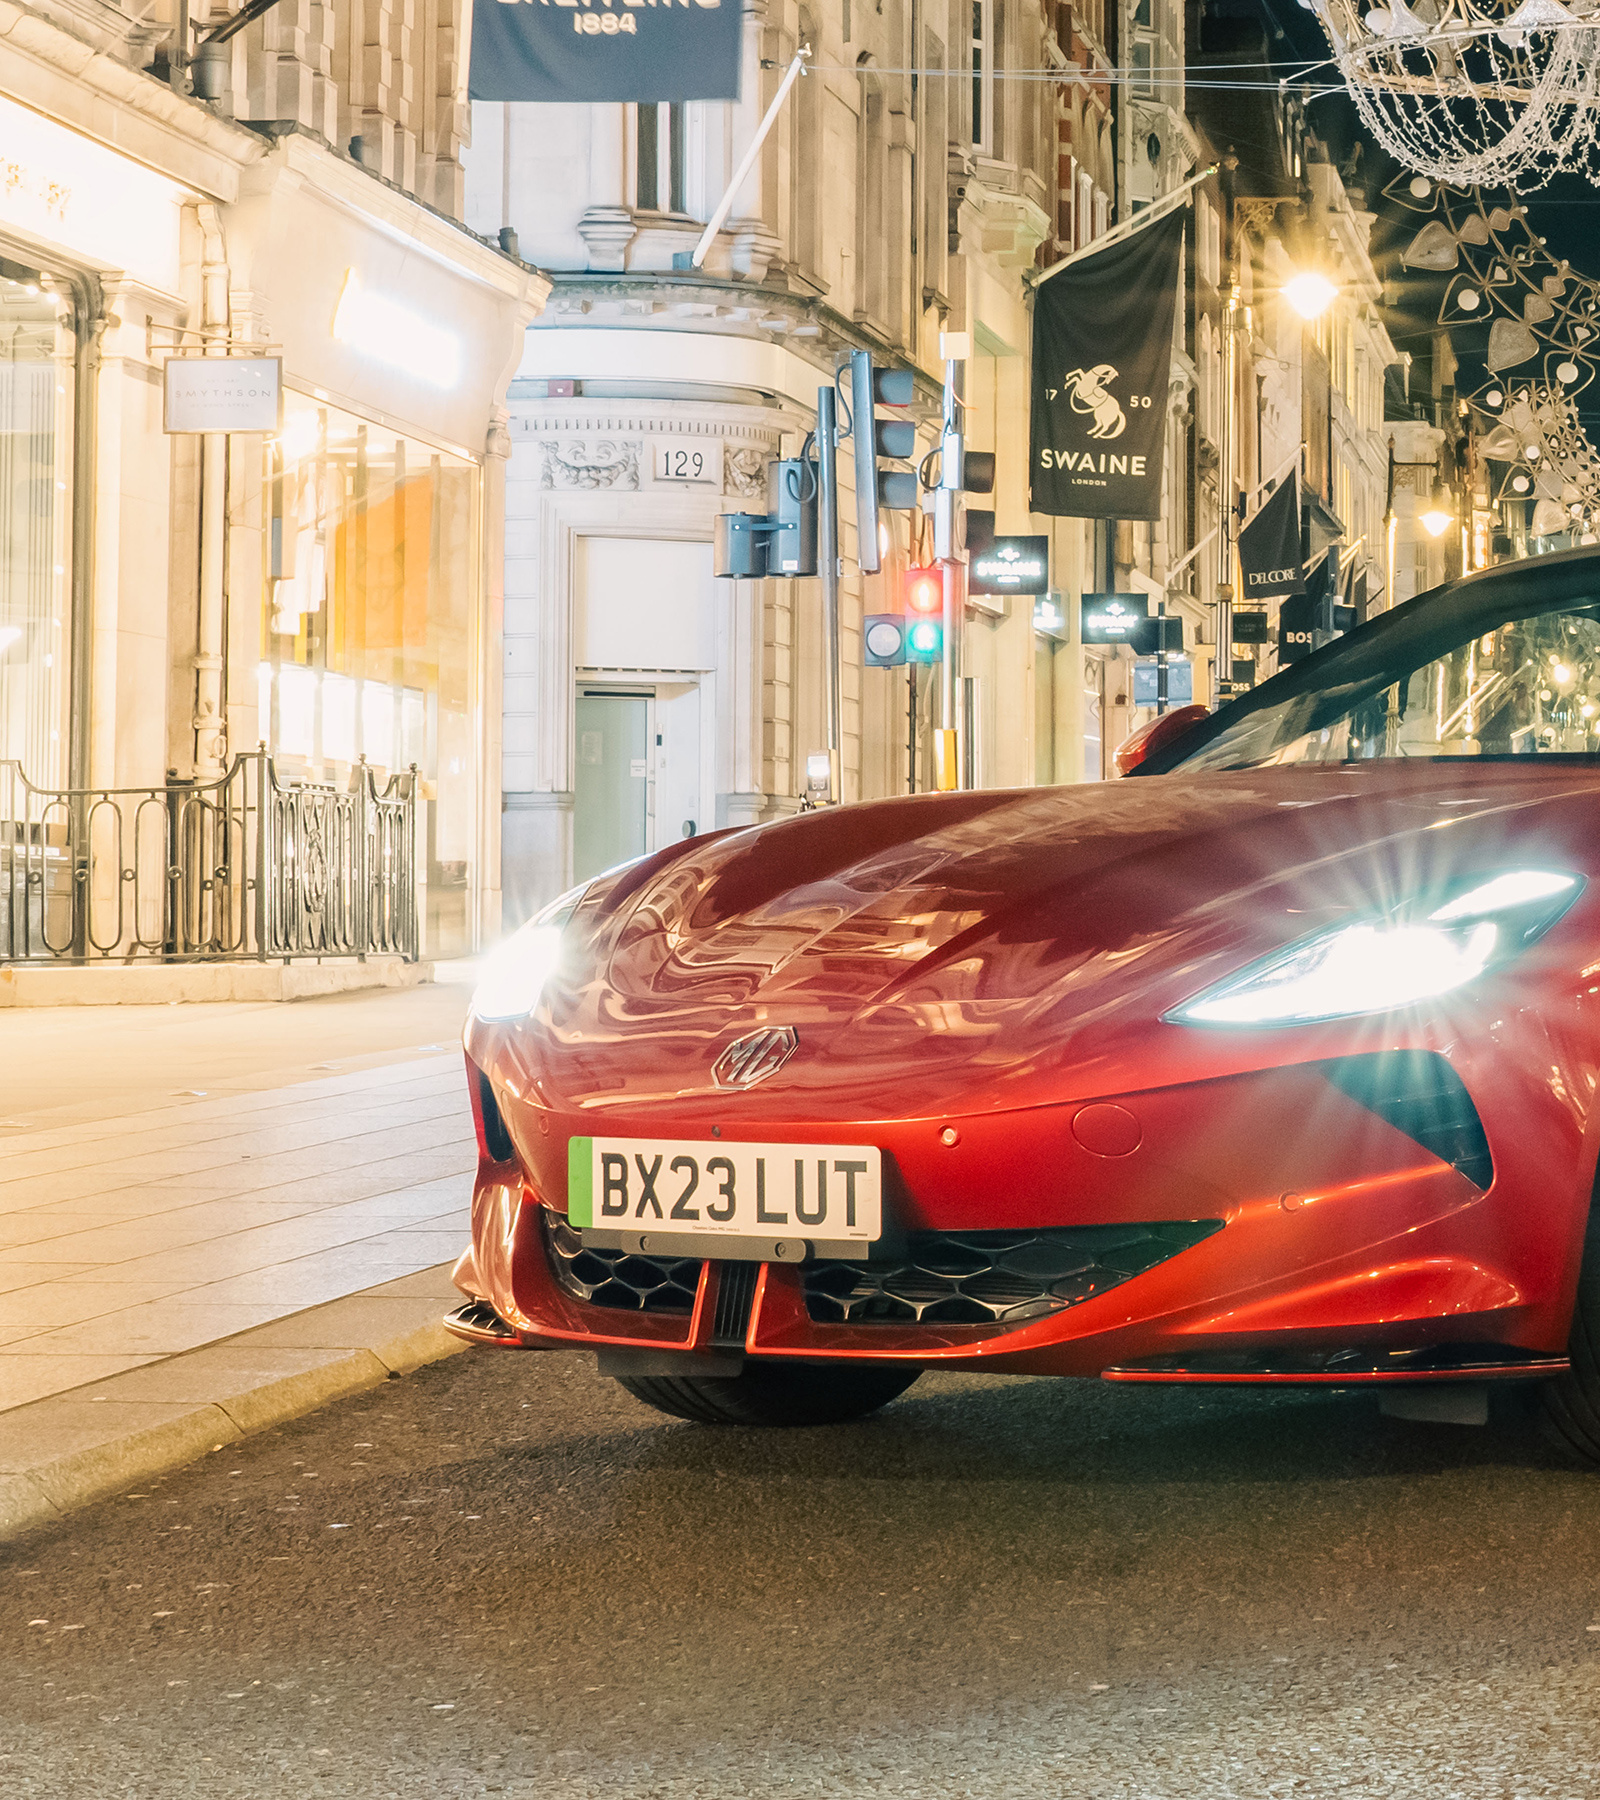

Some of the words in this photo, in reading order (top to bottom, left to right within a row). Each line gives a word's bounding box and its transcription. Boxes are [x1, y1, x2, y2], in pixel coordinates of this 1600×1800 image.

[573, 12, 637, 35] 1884
[175, 389, 271, 399] SMYTHSON
[1045, 388, 1058, 401] 17
[1129, 395, 1152, 408] 50
[664, 450, 704, 478] 129
[1040, 448, 1147, 476] SWAINE
[1071, 478, 1107, 487] LONDON
[1248, 567, 1298, 586] DELCORE
[1286, 631, 1313, 644] BOS
[1230, 682, 1251, 692] OSS
[719, 1030, 790, 1083] MG
[600, 1151, 737, 1222] BX23
[756, 1157, 868, 1227] LUT
